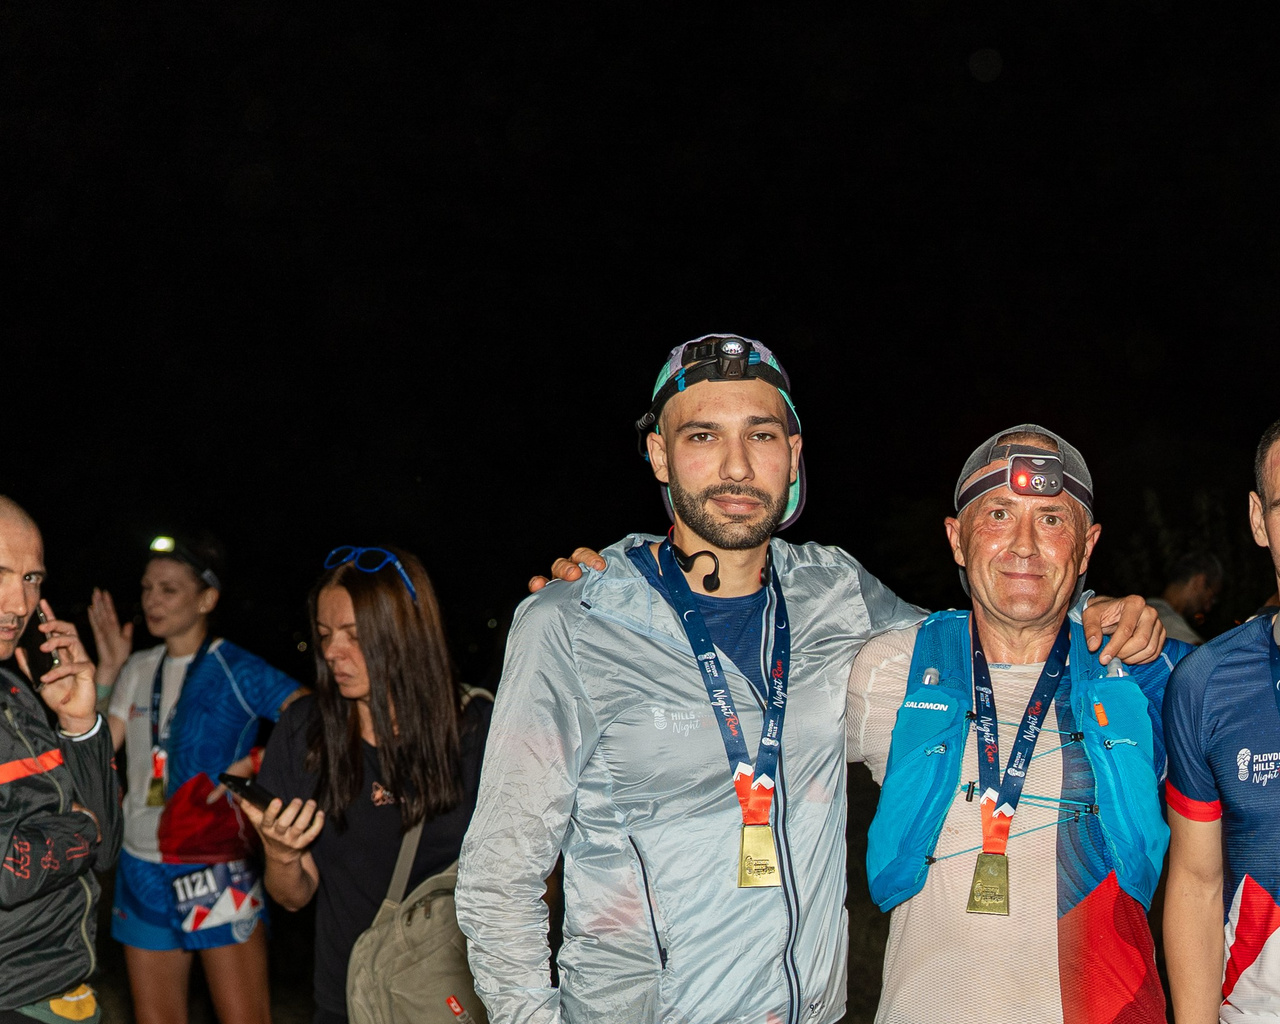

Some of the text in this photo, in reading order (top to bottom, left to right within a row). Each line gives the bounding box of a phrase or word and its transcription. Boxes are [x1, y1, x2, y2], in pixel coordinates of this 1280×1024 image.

[771, 659, 788, 709] Night Run
[711, 689, 739, 737] Night Run
[904, 701, 949, 712] SALOMON
[1023, 701, 1043, 742] Night Run
[672, 720, 701, 737] Night
[976, 716, 998, 764] Night Run
[1252, 769, 1280, 787] Night
[1253, 762, 1275, 772] HILLS
[173, 868, 218, 903] 1121
